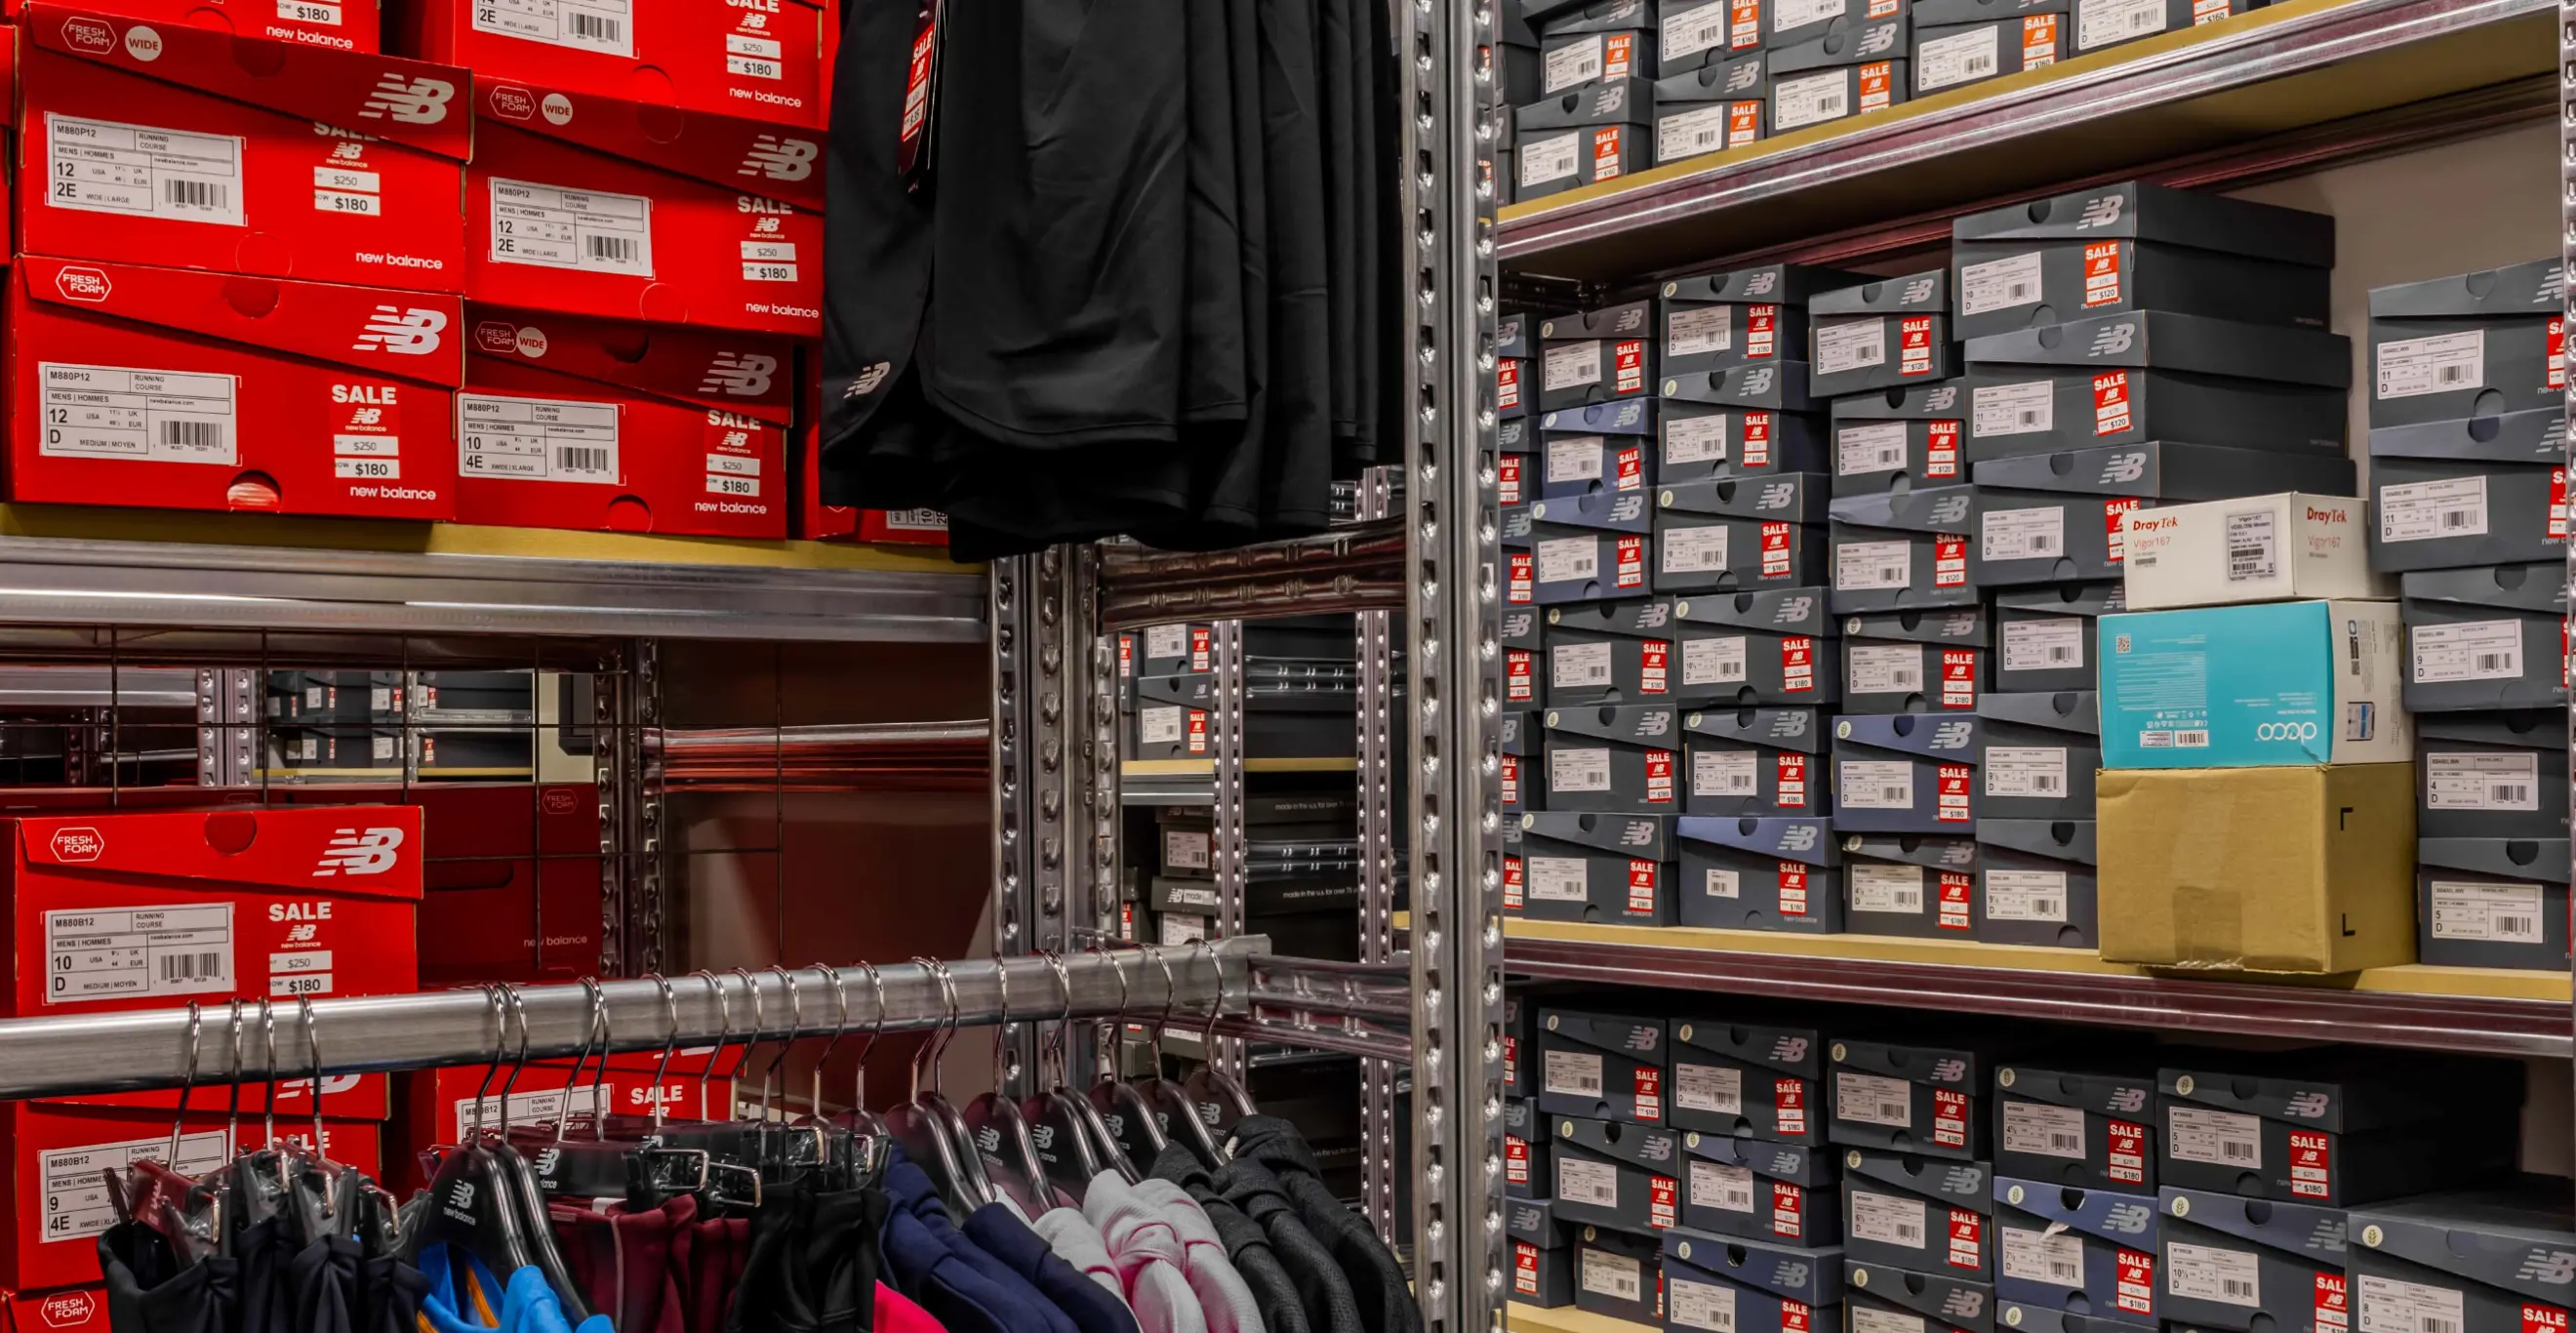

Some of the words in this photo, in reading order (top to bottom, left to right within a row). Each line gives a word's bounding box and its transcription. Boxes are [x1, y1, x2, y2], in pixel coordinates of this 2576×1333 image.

[297, 7, 330, 21] $180
[479, 9, 497, 23] 2E
[2025, 15, 2055, 29] SALE
[68, 23, 106, 38] FRESH
[266, 24, 296, 40] new
[297, 27, 353, 50] balance
[76, 33, 111, 49] FOAM
[129, 37, 159, 52] WIDE
[743, 42, 763, 53] $250
[744, 61, 772, 76] $180
[1861, 64, 1889, 79] SALE
[496, 93, 527, 104] FRESH
[729, 87, 755, 101] new
[755, 89, 801, 108] balance
[502, 101, 531, 113] FOAM
[544, 102, 571, 116] WIDE
[1732, 103, 1756, 116] SALE
[57, 125, 97, 139] M880P12
[139, 133, 169, 143] RUNNING
[1595, 131, 1619, 145] SALE
[58, 146, 78, 156] MENS
[84, 149, 114, 160] HOMMES
[140, 141, 167, 151] COURSE
[56, 161, 75, 178] 12
[334, 176, 358, 187] $250
[57, 182, 77, 198] 2E
[499, 187, 530, 198] M880P12
[335, 197, 369, 212] $180
[520, 209, 545, 218] HOMMES
[499, 221, 513, 234] 12
[499, 238, 514, 253] 2E
[757, 246, 778, 258] $250
[2085, 243, 2117, 262] SALE
[356, 251, 383, 265] new
[386, 252, 443, 270] balance
[62, 273, 100, 286] FRESH
[759, 265, 787, 280] $180
[70, 282, 105, 295] FOAM
[2099, 287, 2116, 300] $120
[745, 301, 772, 314] new
[773, 303, 820, 319] balance
[1750, 306, 1774, 317] SALE
[481, 327, 511, 339] FRESH
[1903, 319, 1930, 333] SALE
[487, 335, 515, 346] FOAM
[519, 337, 544, 349] WIDE
[1911, 362, 1925, 371] $120
[51, 371, 90, 382] M880P12
[135, 374, 165, 383] RUNNING
[2094, 373, 2125, 391] SALE
[2381, 370, 2391, 381] 11
[78, 394, 109, 403] HOMMES
[332, 384, 397, 405] SALE
[466, 403, 500, 413] M880P12
[49, 408, 67, 424] 12
[707, 410, 761, 430] SALE
[2111, 417, 2126, 428] $120
[1929, 423, 1956, 434] SALE
[50, 429, 61, 444] D
[466, 436, 481, 450] 10
[353, 440, 378, 452] $250
[466, 456, 483, 468] 4E
[722, 461, 743, 471] $250
[355, 463, 388, 477] $180
[350, 485, 379, 499] new
[381, 486, 436, 502] balance
[722, 480, 750, 495] $180
[695, 502, 719, 512] new
[720, 502, 767, 515] balance
[2307, 506, 2348, 524] DrayTek
[2133, 516, 2179, 532] DrayTek
[2385, 513, 2395, 523] 11
[2133, 536, 2171, 550] Vigor167
[2308, 535, 2342, 550] Vigor167
[1783, 639, 1810, 651] SALE
[1944, 654, 1973, 665] SALE
[2257, 722, 2317, 747] deco
[1780, 755, 1804, 767] SALE
[1939, 766, 1969, 780] SALE
[1787, 795, 1802, 805] $180
[57, 837, 94, 847] FRESH
[64, 844, 98, 855] FOAM
[1630, 862, 1654, 873] SALE
[268, 902, 332, 921] SALE
[55, 918, 95, 928] M880B12
[57, 939, 76, 948] MENS
[82, 938, 111, 947] HOMMES
[55, 955, 72, 970] 10
[287, 956, 311, 968] $250
[55, 977, 65, 991] D
[289, 977, 321, 991] $180
[630, 1085, 683, 1105] SALE
[1776, 1082, 1801, 1095] SALE
[1936, 1091, 1965, 1105] SALE
[2110, 1124, 2142, 1139] SALE
[1948, 1135, 1963, 1146] $180
[2291, 1136, 2326, 1150] SALE
[131, 1146, 160, 1155] RUNNING
[50, 1156, 89, 1168] M880B12
[2123, 1171, 2140, 1181] $180
[2304, 1184, 2322, 1194] $180
[50, 1196, 59, 1211] 9
[443, 1206, 456, 1218] new
[455, 1208, 476, 1227] balance
[1951, 1210, 1980, 1226] SALE
[50, 1217, 70, 1232] 4E
[48, 1299, 84, 1312] FRESH
[55, 1306, 89, 1319] FOAM
[2523, 1308, 2566, 1327] SALE
